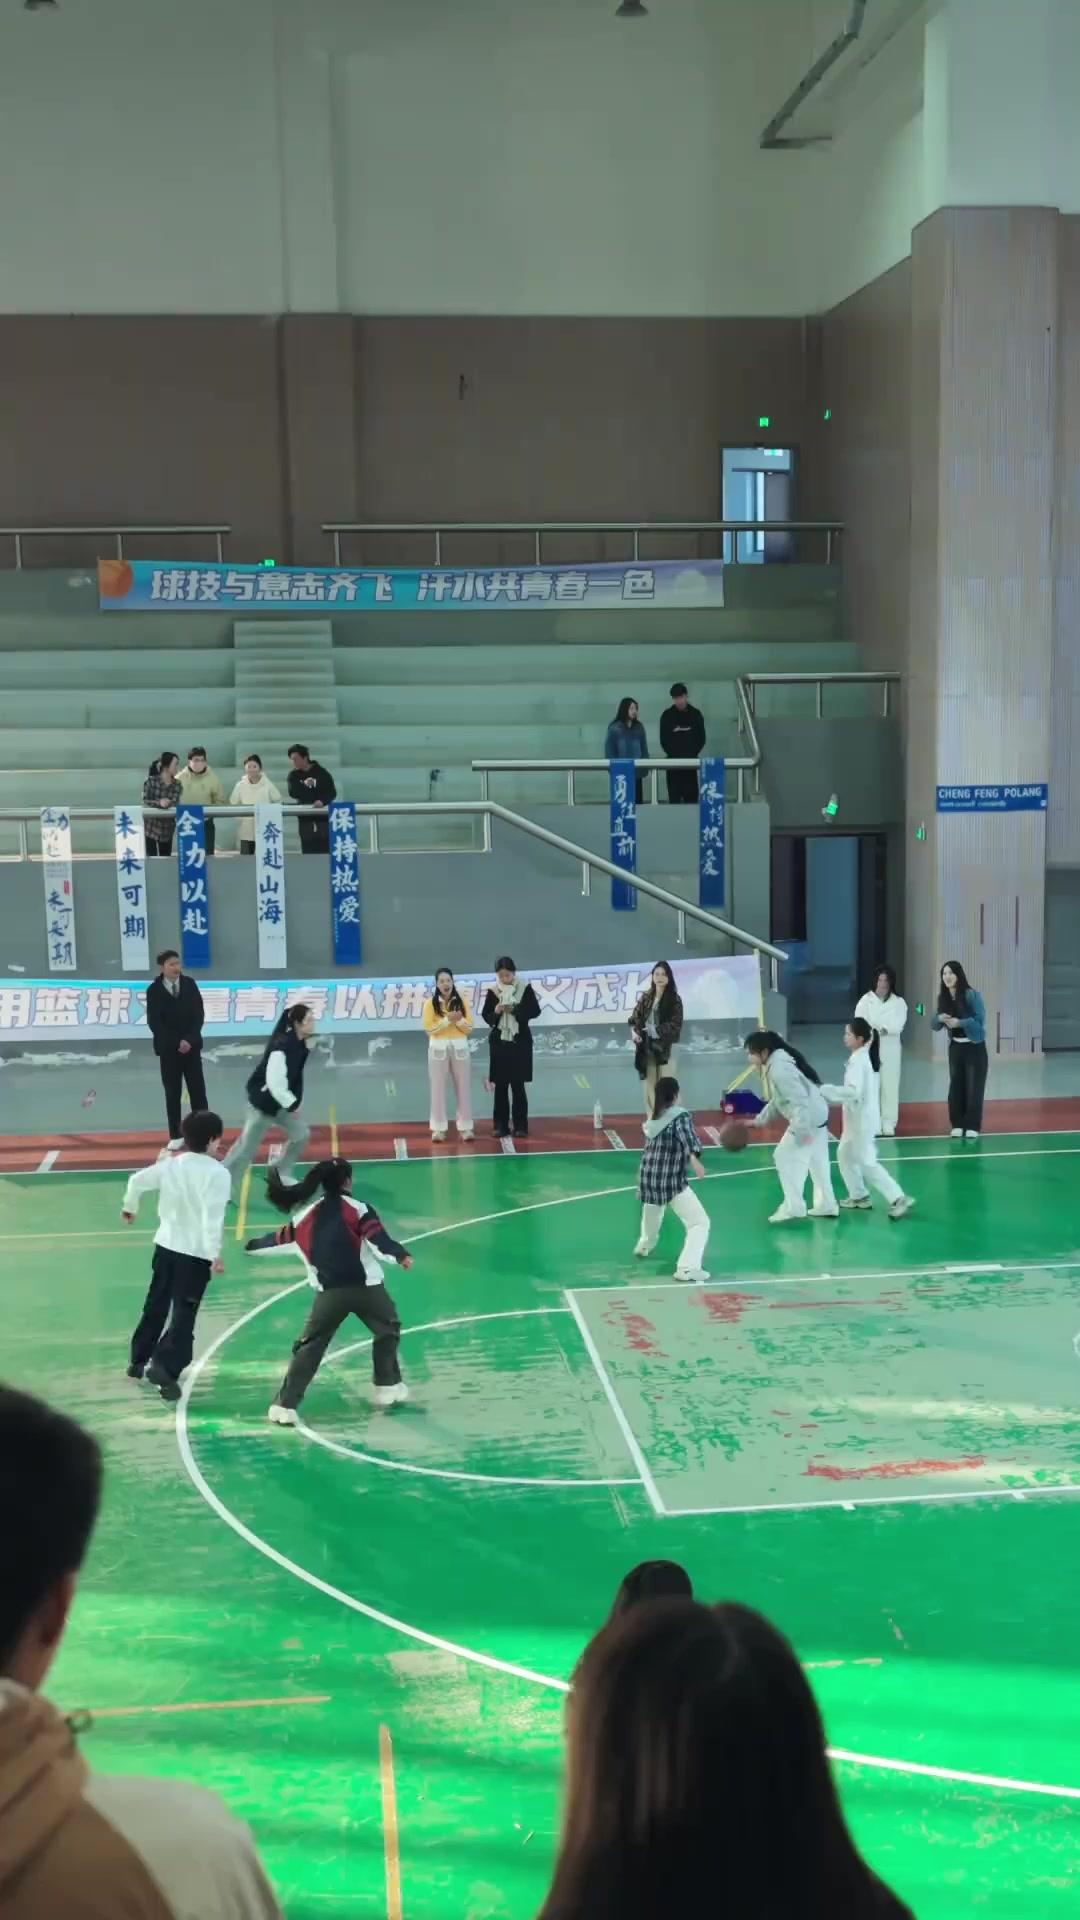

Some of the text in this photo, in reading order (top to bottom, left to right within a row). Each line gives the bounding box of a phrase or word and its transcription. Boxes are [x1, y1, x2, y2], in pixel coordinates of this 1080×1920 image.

[151, 569, 655, 601] 球技与意志齐飞 汗水共青春一色
[610, 774, 637, 862] 勇往直前
[700, 780, 724, 876] 保持热爱
[938, 786, 1042, 799] CHENG FENG POLANG
[115, 811, 146, 939] 未来可期
[176, 809, 209, 936] 全力以赴
[259, 820, 284, 925] 奔赴山海
[329, 807, 361, 923] 保持热爱
